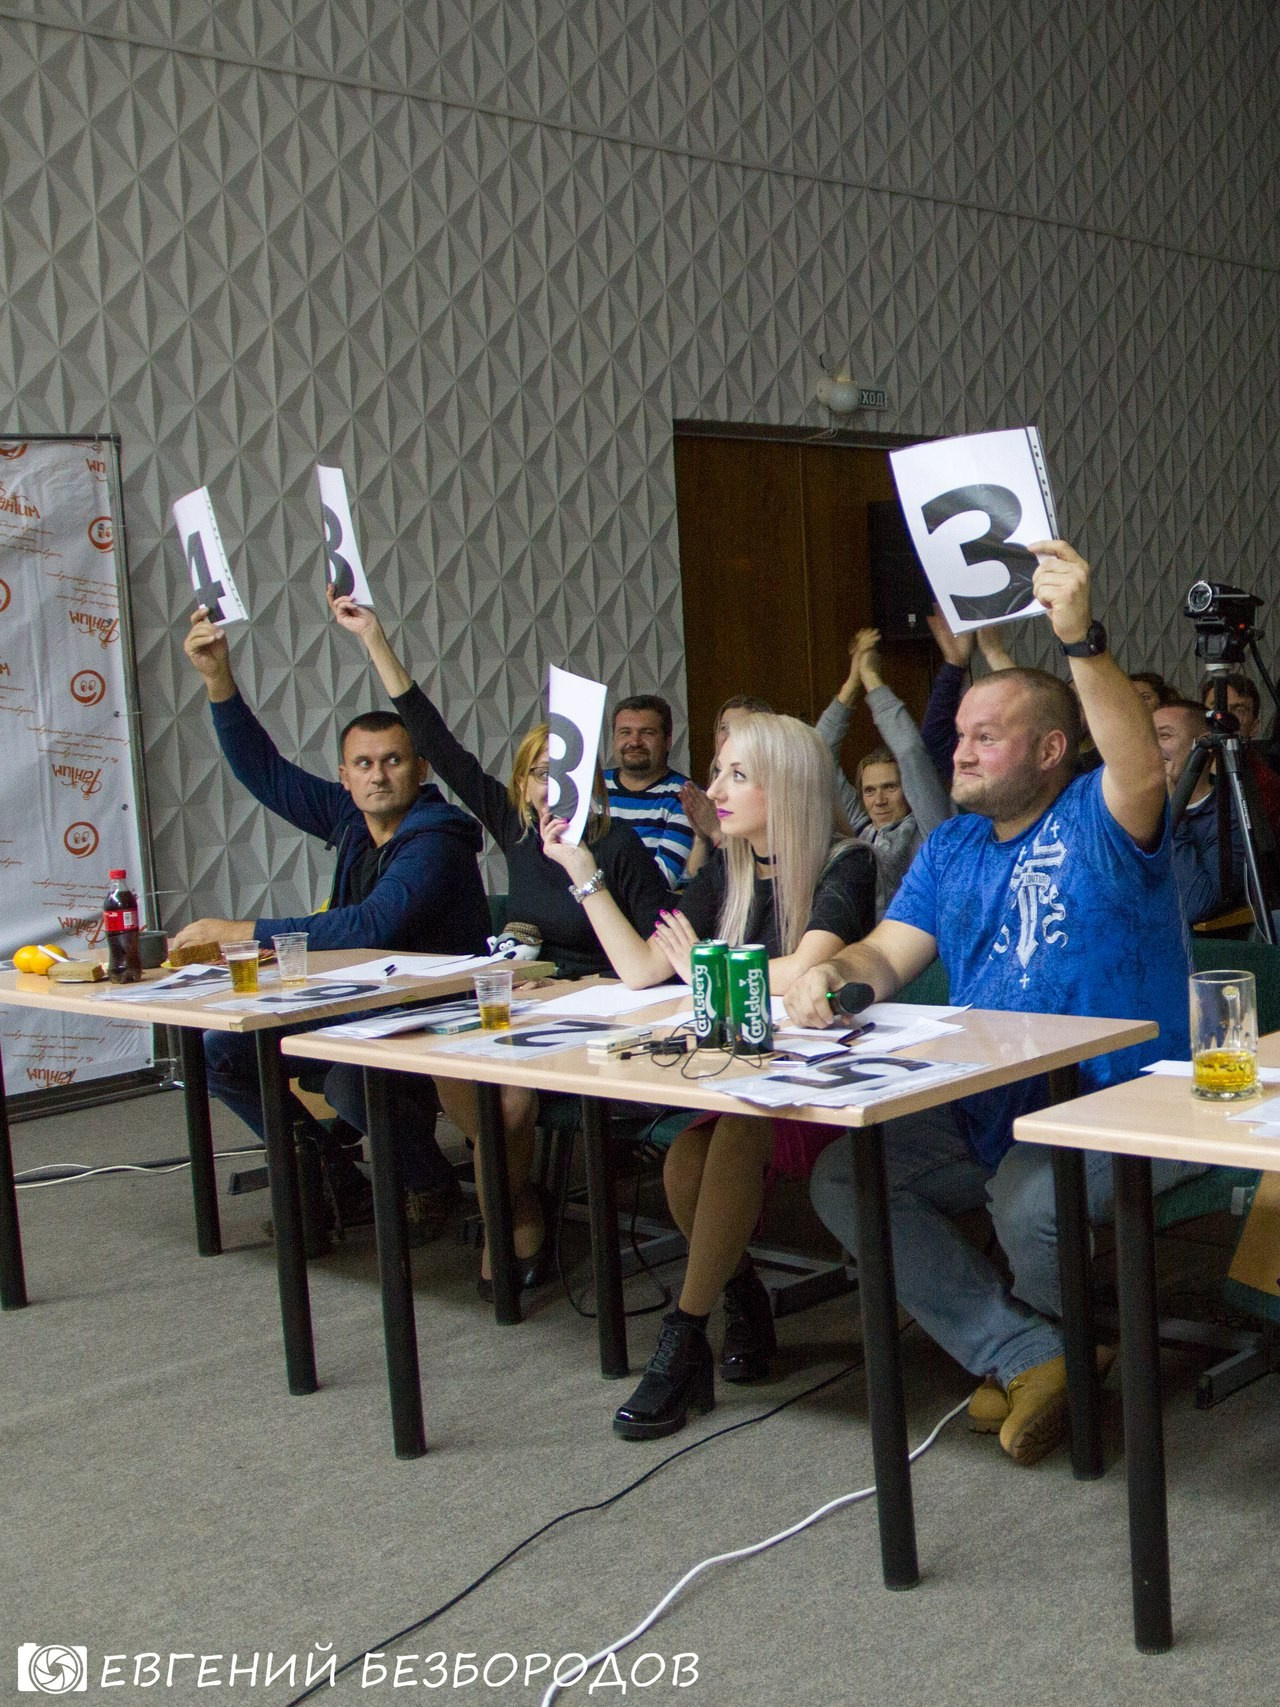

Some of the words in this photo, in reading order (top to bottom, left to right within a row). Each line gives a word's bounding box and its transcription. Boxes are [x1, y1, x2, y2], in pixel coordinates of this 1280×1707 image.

[859, 390, 885, 406] ХОД
[187, 531, 226, 625] 4
[921, 483, 1041, 621] 3
[694, 964, 717, 1037] Carlsberg
[741, 968, 770, 1044] Carlsberg
